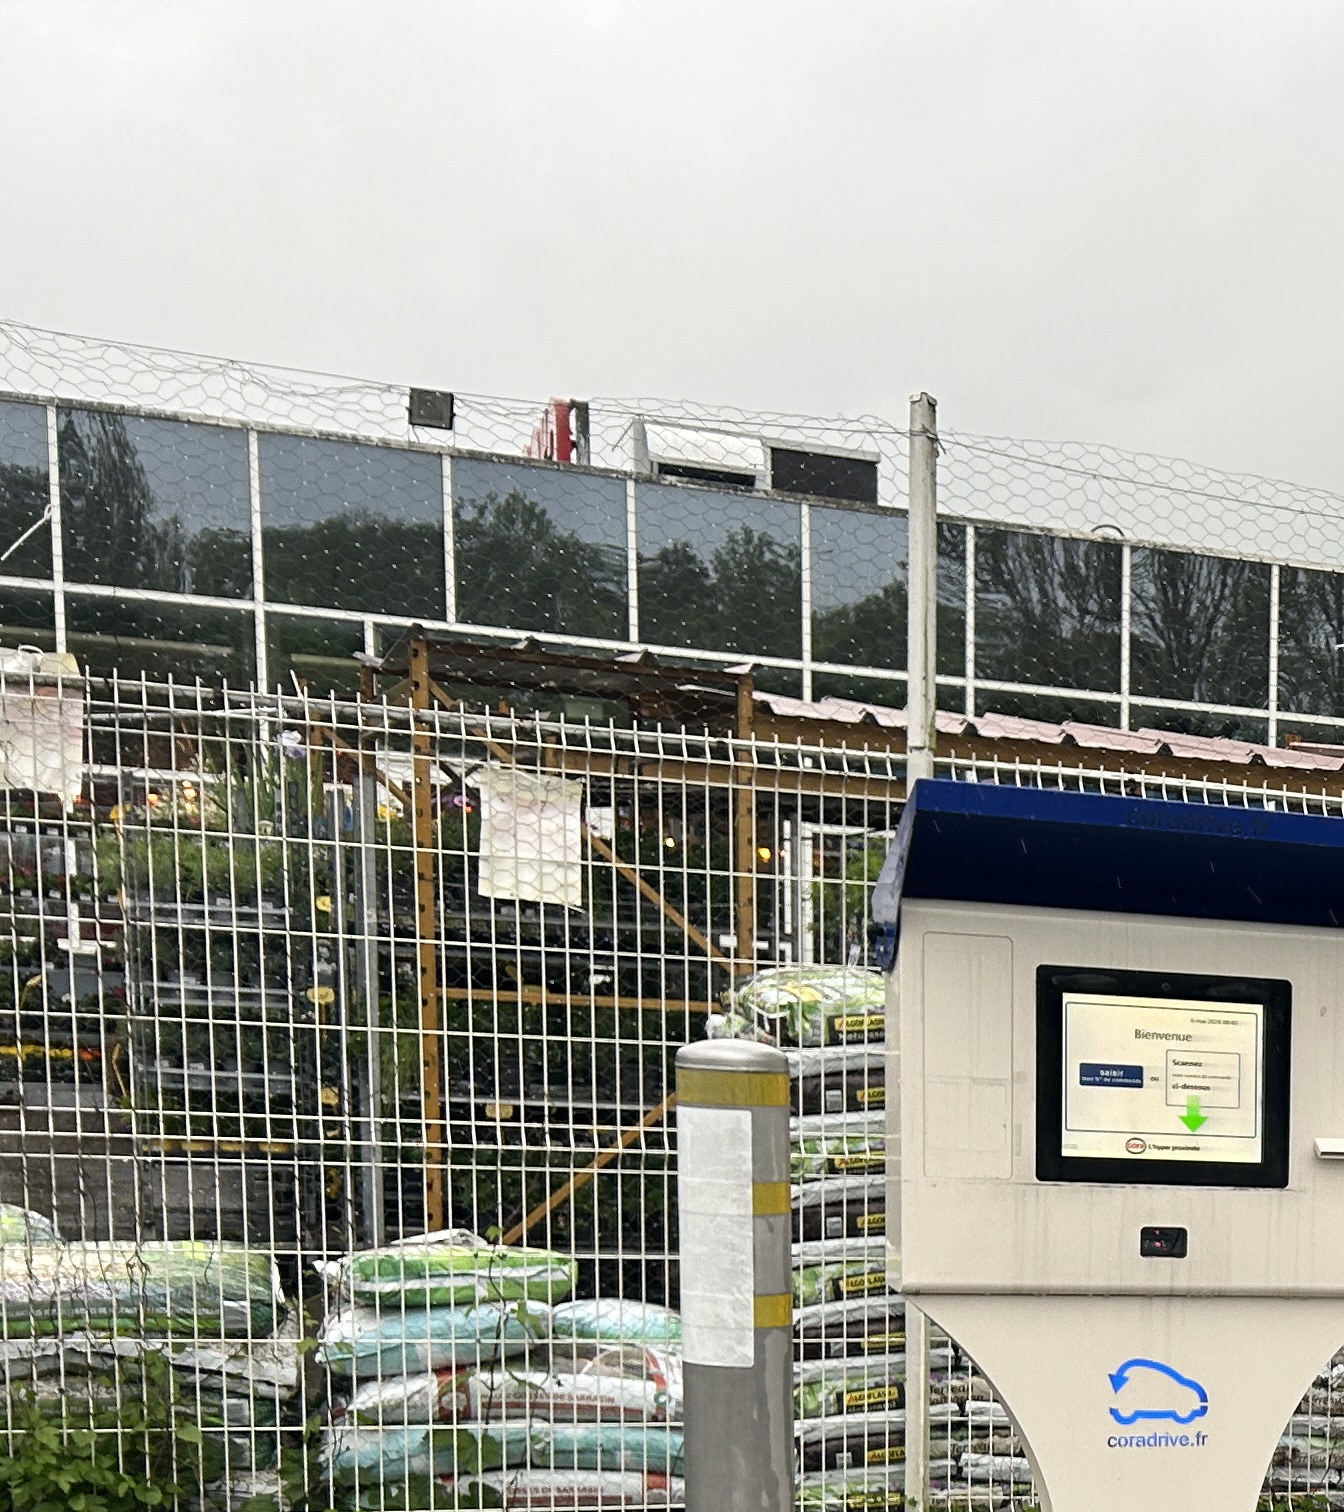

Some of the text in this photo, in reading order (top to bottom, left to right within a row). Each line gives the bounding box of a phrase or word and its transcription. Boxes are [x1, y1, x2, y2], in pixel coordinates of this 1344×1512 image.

[1135, 1028, 1193, 1043] Bienvenue
[1172, 1059, 1203, 1068] Scannez
[1100, 1069, 1124, 1077] saisir
[1107, 1430, 1208, 1448] coradrive.fr
